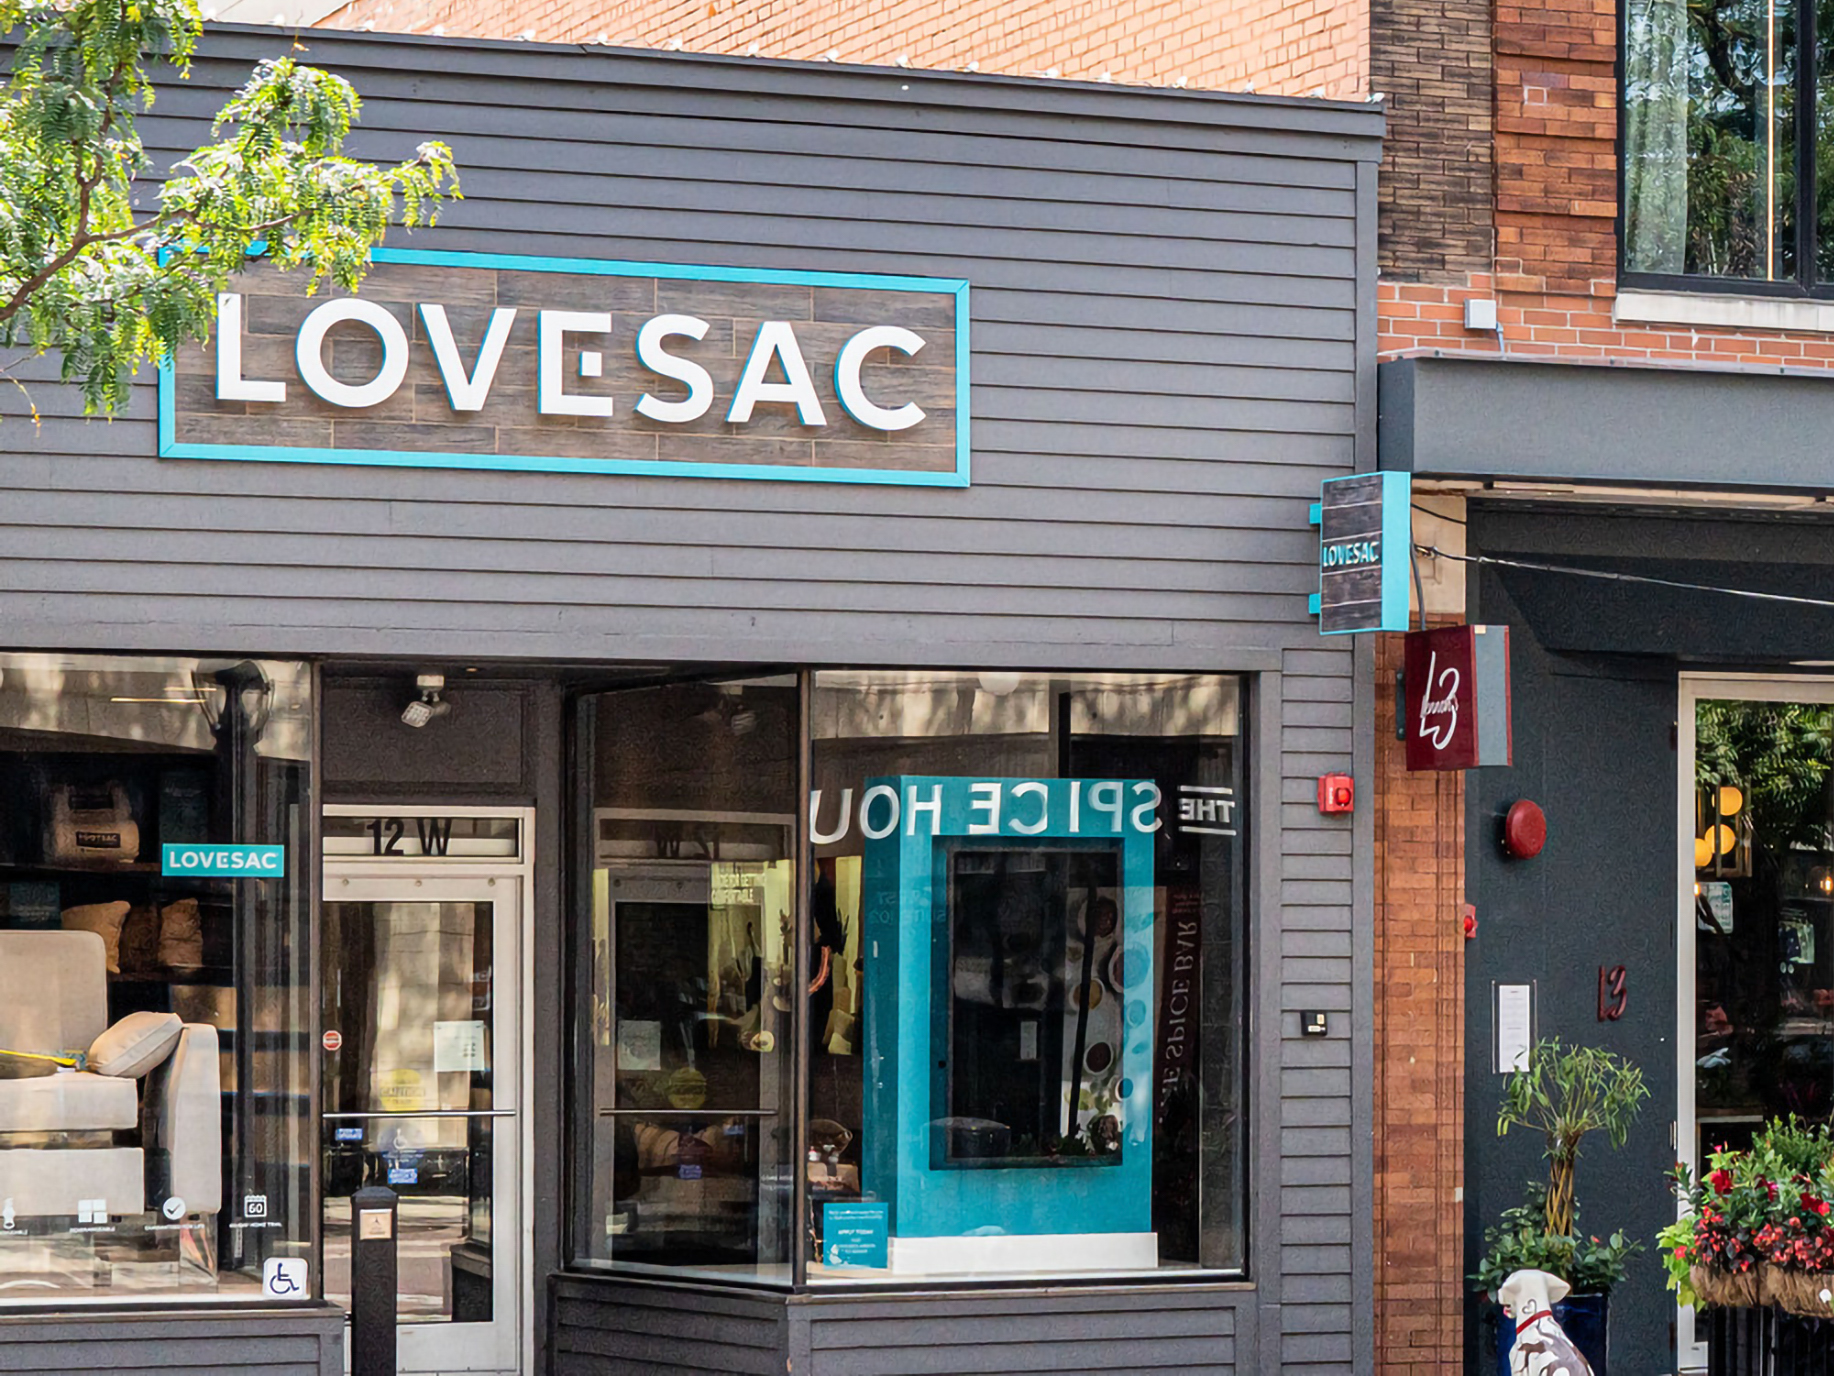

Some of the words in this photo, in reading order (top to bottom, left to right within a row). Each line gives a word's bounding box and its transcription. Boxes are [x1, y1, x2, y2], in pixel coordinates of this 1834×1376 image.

[216, 292, 928, 432] LOVESAC
[1322, 540, 1379, 568] LOVESAC
[366, 818, 404, 856] 12
[416, 818, 452, 856] W
[169, 851, 278, 869] LOVESAC
[248, 1202, 263, 1214] 60
